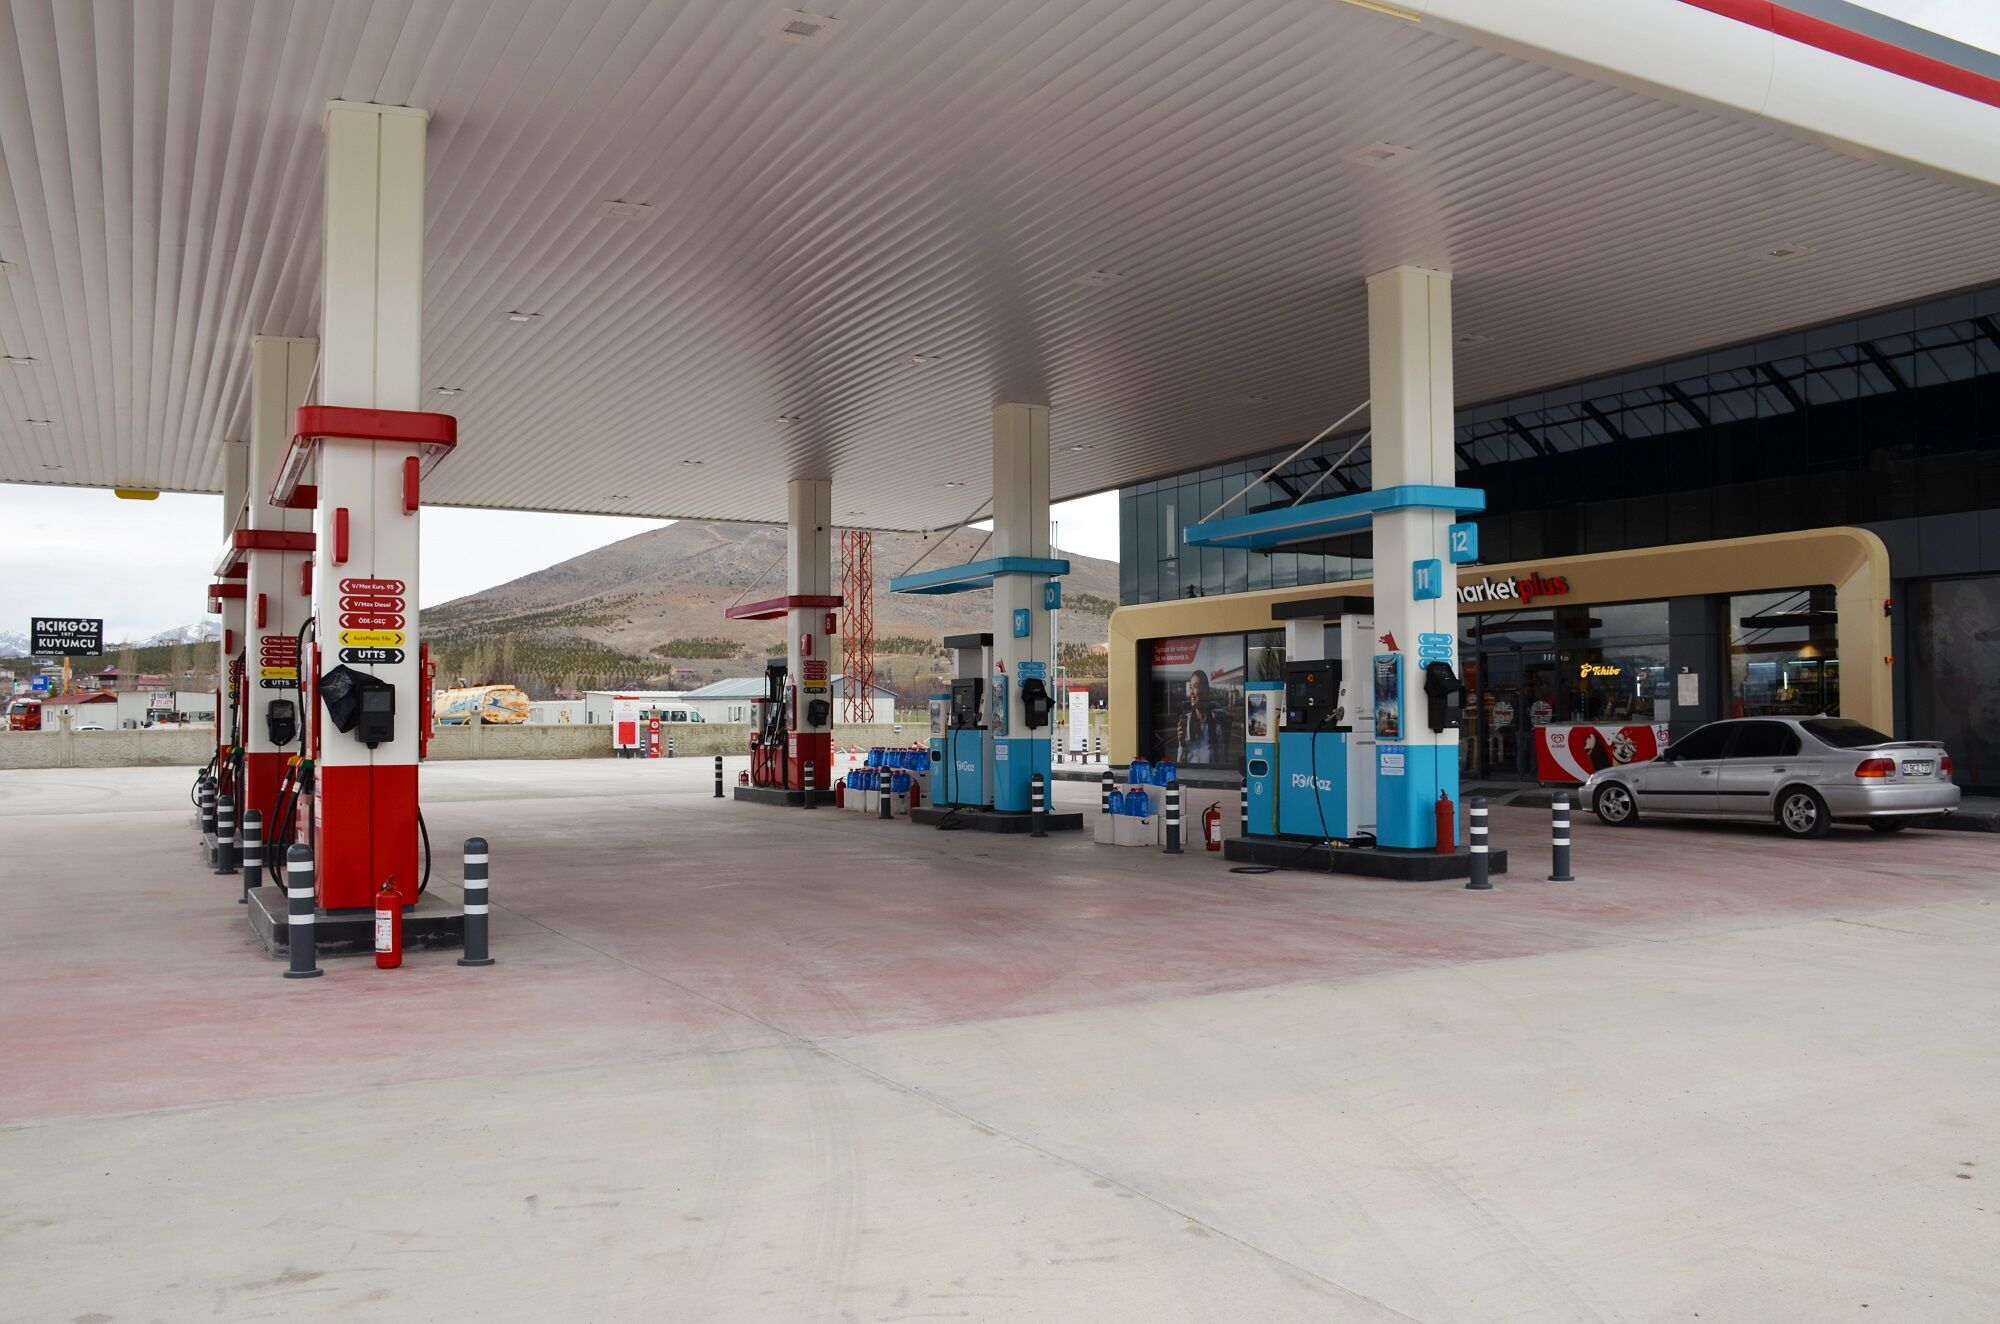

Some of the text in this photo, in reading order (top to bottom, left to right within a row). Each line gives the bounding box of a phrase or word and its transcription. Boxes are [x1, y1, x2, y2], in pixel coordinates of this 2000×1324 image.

[1451, 531, 1468, 553] 12
[1416, 568, 1429, 590] 11
[36, 619, 98, 633] AÇIKGÖZ
[39, 638, 95, 648] KUYUMCU
[357, 650, 386, 659] UTTS
[1592, 665, 1621, 676] Tchibo
